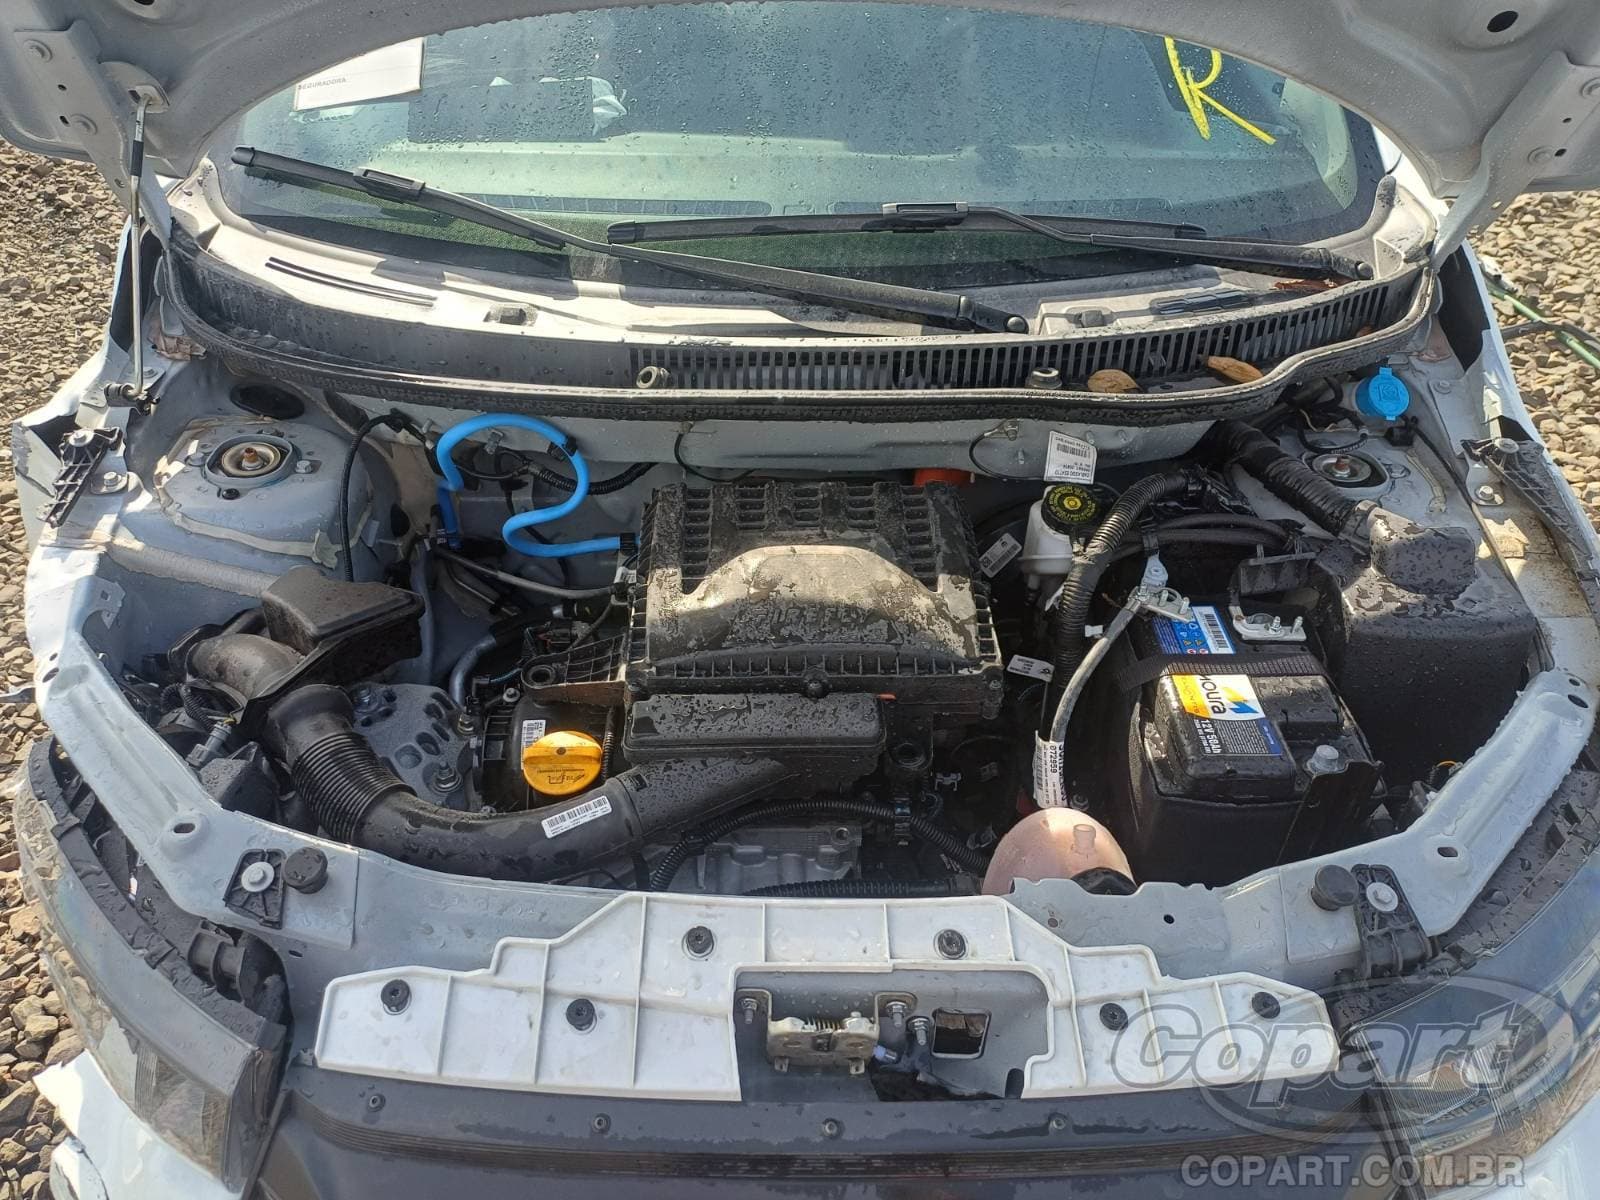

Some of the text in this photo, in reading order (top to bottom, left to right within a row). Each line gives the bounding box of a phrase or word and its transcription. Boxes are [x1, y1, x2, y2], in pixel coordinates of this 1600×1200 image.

[1164, 35, 1277, 145] R
[751, 606, 870, 624] FIREFLY
[1200, 719, 1214, 733] 12V
